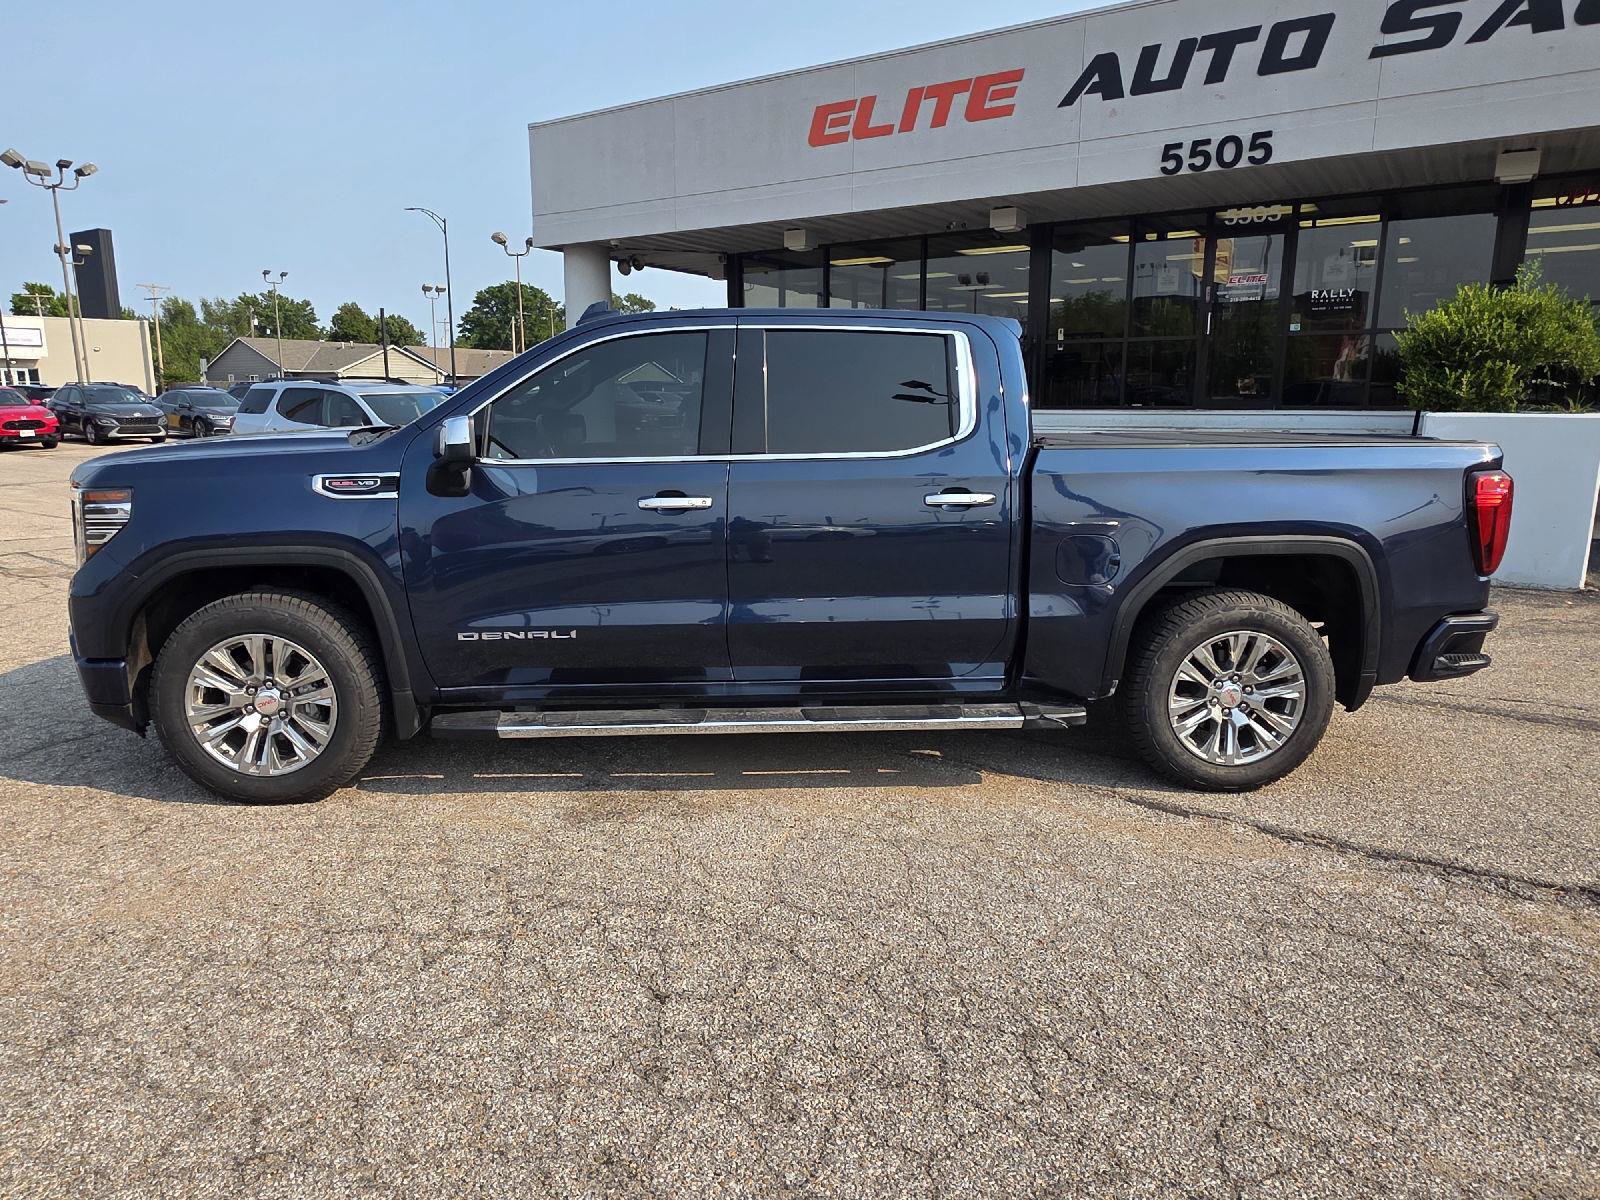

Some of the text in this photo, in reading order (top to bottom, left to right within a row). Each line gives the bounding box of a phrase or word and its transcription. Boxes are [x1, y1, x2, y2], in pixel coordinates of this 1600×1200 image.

[808, 68, 1025, 148] ELITE
[1057, 12, 1336, 108] AUTO
[1160, 130, 1273, 175] 5505
[1227, 274, 1268, 286] ELITE
[1311, 288, 1355, 299] RALLY
[457, 630, 577, 641] DENALI
